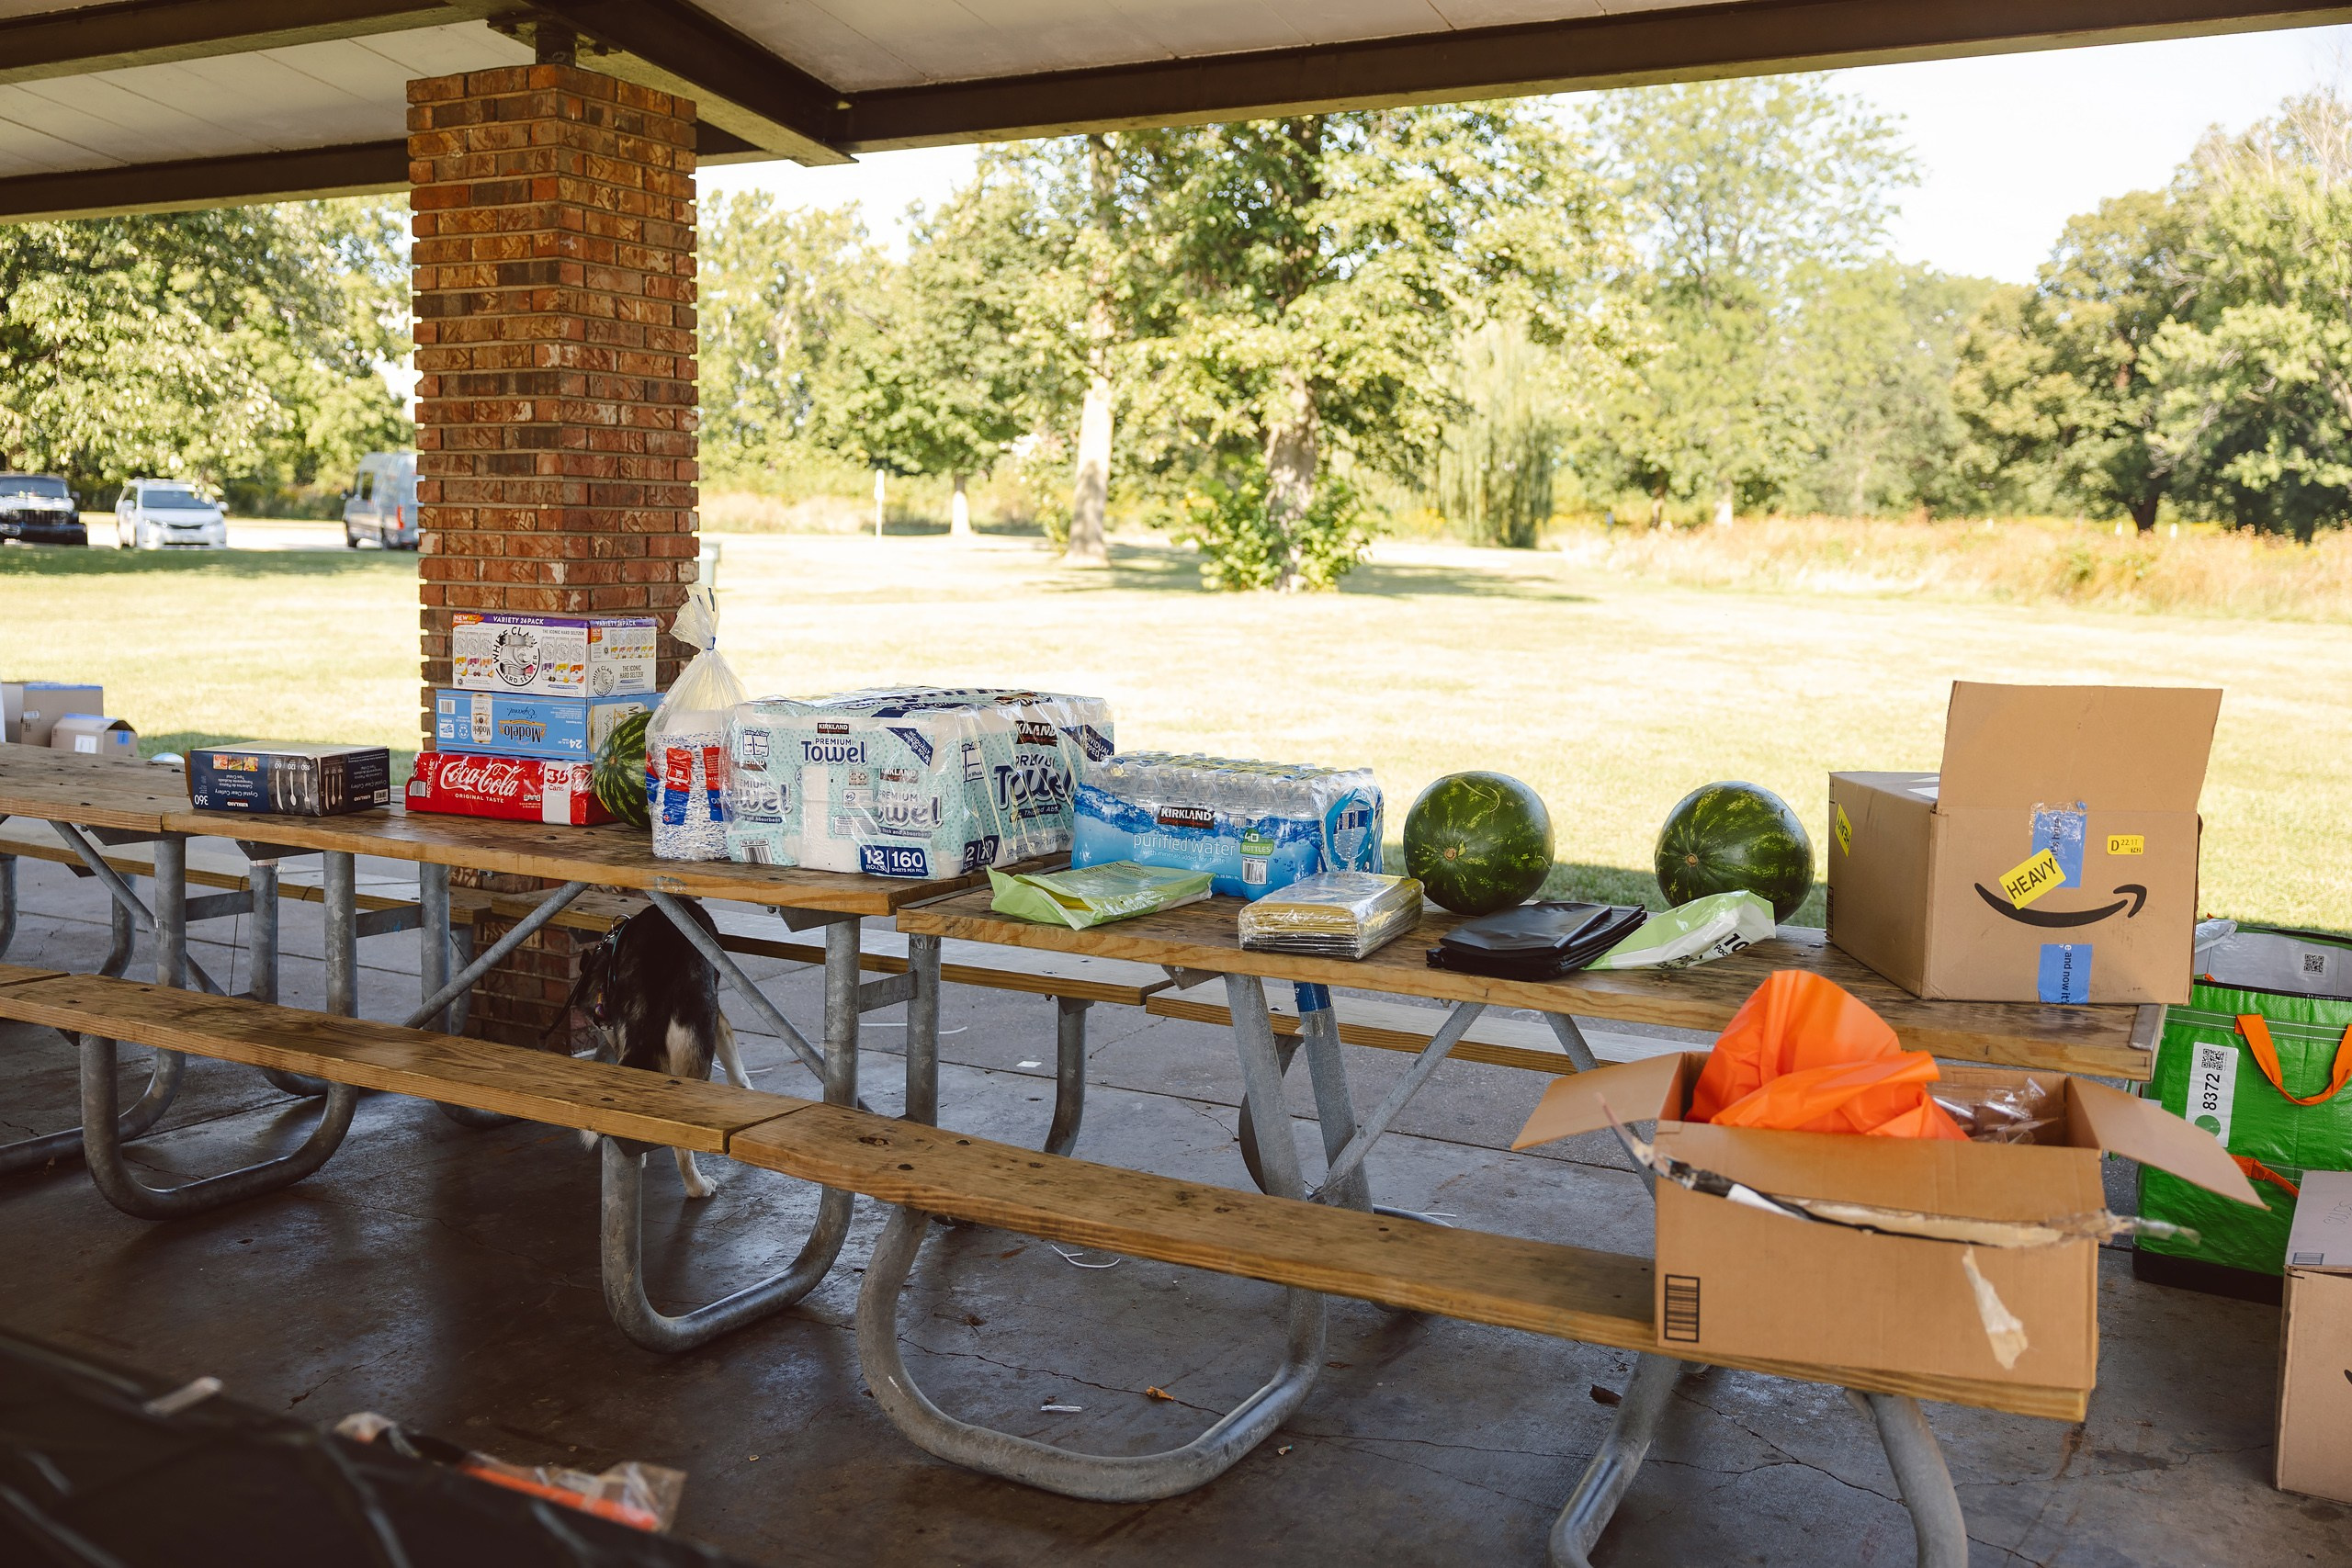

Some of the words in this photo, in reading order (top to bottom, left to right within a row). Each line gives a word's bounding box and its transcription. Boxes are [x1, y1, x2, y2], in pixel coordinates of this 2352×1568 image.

[492, 615, 519, 625] VARIETY
[818, 722, 849, 730] KIRKLAND
[503, 725, 541, 742] Modelo
[569, 739, 582, 749] 24
[815, 738, 852, 746] PREMIUM
[800, 740, 866, 764] Towel
[440, 761, 525, 796] Coca-Cola
[547, 768, 570, 785] 35
[214, 787, 231, 796] Cutlery
[243, 790, 258, 798] Crystal
[194, 794, 209, 806] 360
[455, 793, 484, 801] ORIGINAL
[485, 795, 504, 804] TASTE
[1161, 807, 1214, 821] KIRKLAND
[1244, 832, 1260, 842] 40
[1133, 833, 1187, 852] purified
[1191, 839, 1236, 856] water
[1242, 844, 1271, 853] BOTTLES
[2110, 840, 2120, 852] D
[865, 849, 885, 865] 12
[891, 851, 924, 868] 160
[1158, 851, 1182, 860] minerals
[1181, 852, 1196, 862] added
[1209, 856, 1226, 864] taste
[2006, 857, 2058, 900] HEAVY
[1714, 944, 1729, 956] Pac
[2064, 952, 2073, 970] and
[2062, 971, 2071, 990] now
[2202, 1073, 2221, 1111] 8372
